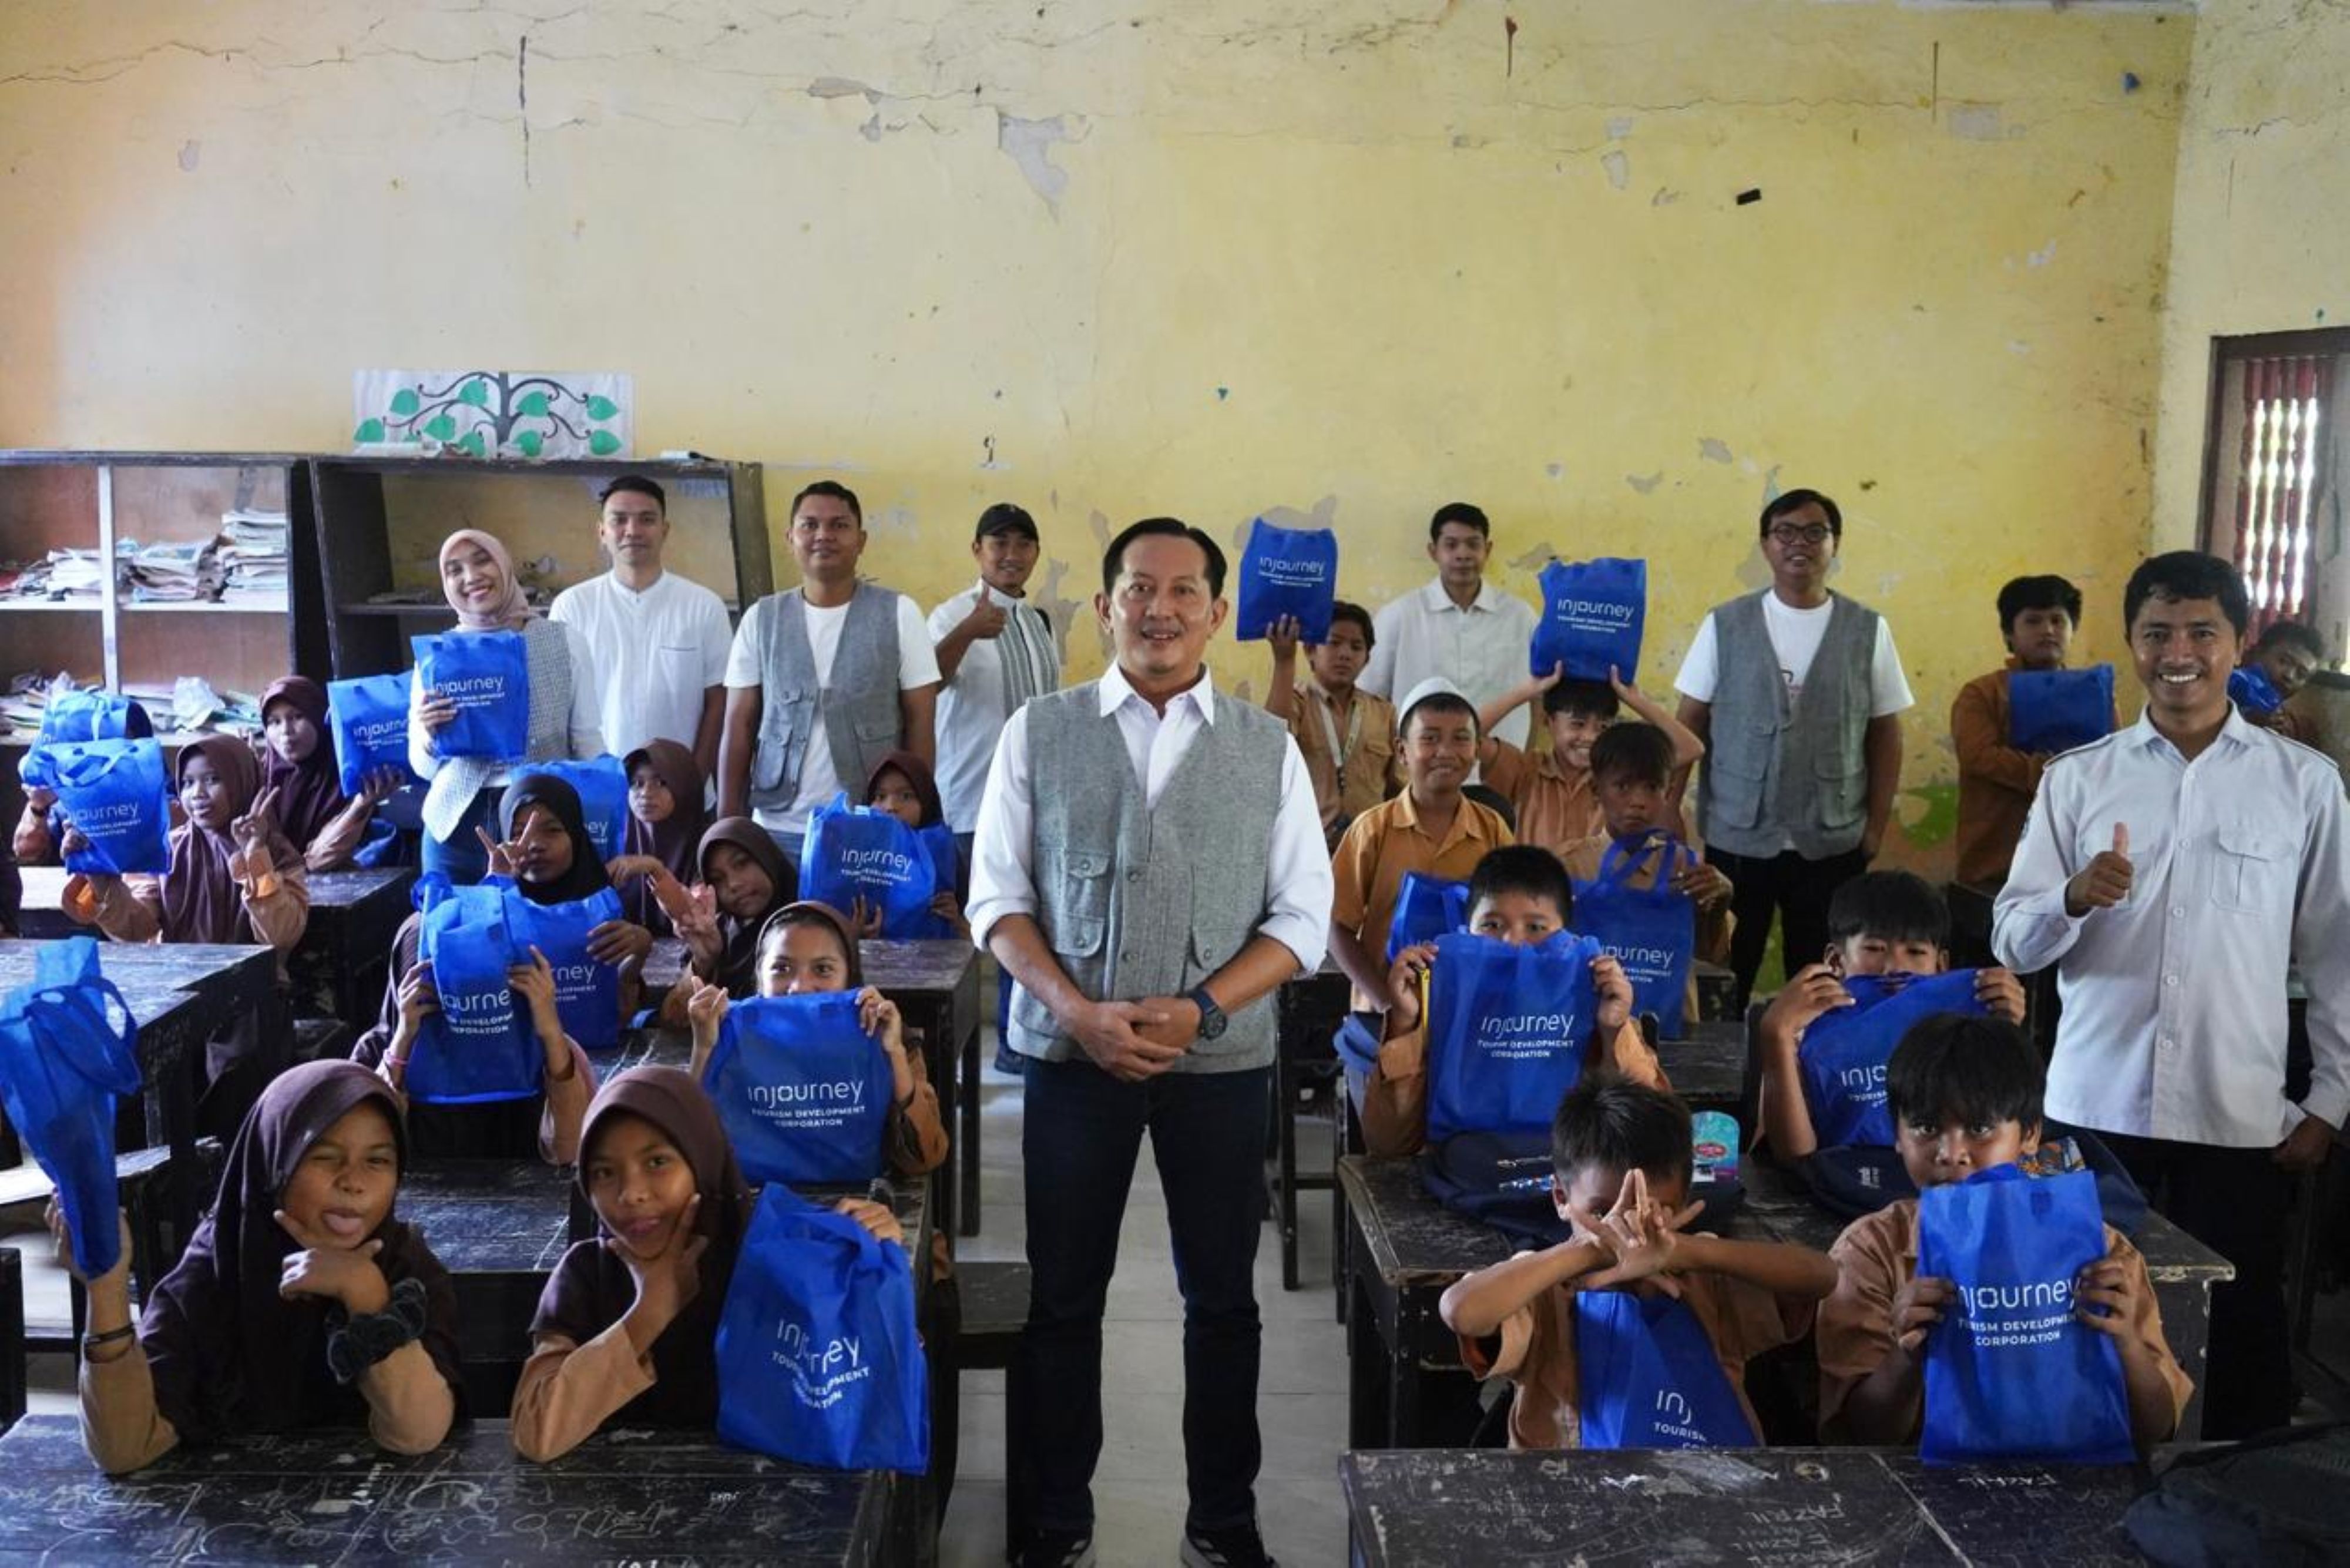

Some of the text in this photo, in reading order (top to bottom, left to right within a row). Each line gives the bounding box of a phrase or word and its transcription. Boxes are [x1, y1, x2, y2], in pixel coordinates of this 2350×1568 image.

[436, 676, 503, 696] njourney
[748, 1080, 864, 1109] injourney
[795, 1104, 865, 1118] DEVELOPMENT
[1959, 1277, 2080, 1318] njourney
[1975, 1331, 2060, 1346] CORPORATION
